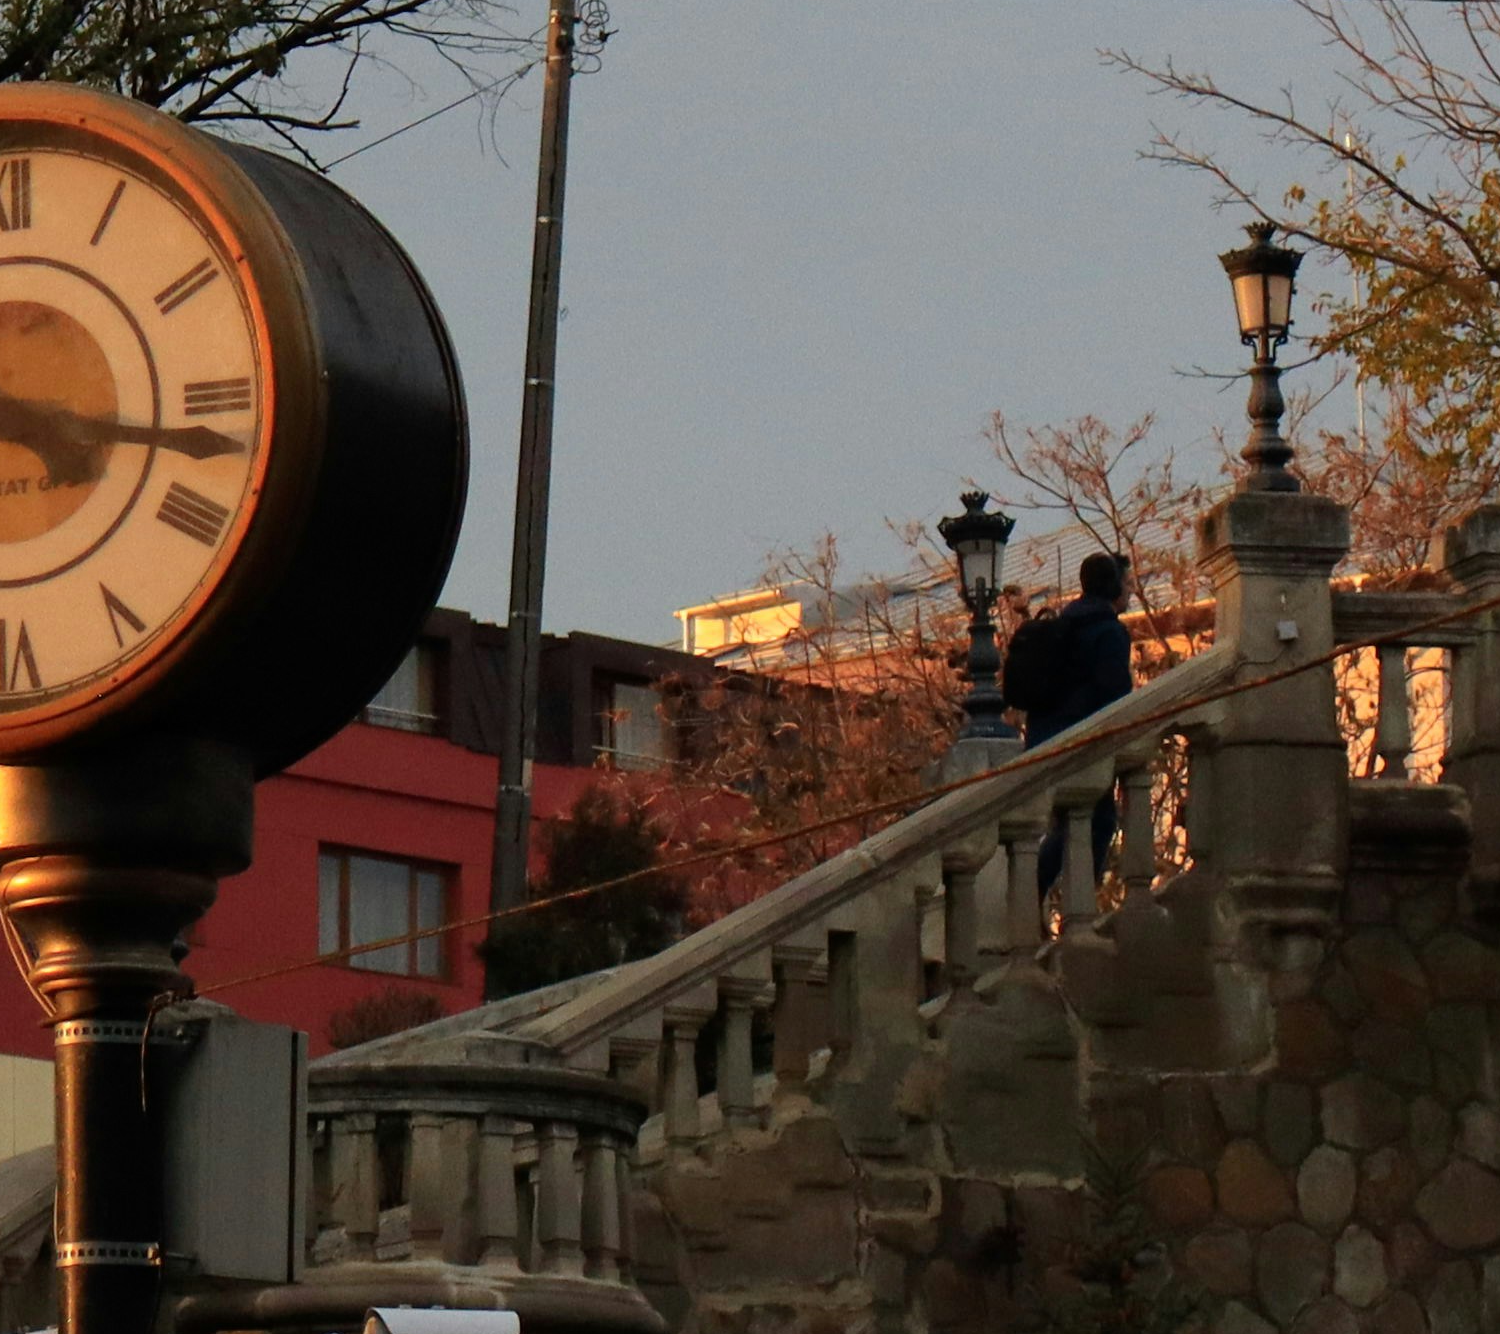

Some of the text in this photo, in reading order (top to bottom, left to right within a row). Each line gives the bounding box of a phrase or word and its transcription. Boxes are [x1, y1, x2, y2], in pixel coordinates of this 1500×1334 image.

[90, 179, 126, 246] I
[155, 258, 219, 315] II
[185, 378, 251, 414] III
[156, 481, 230, 547] IIII
[99, 582, 146, 648] V
